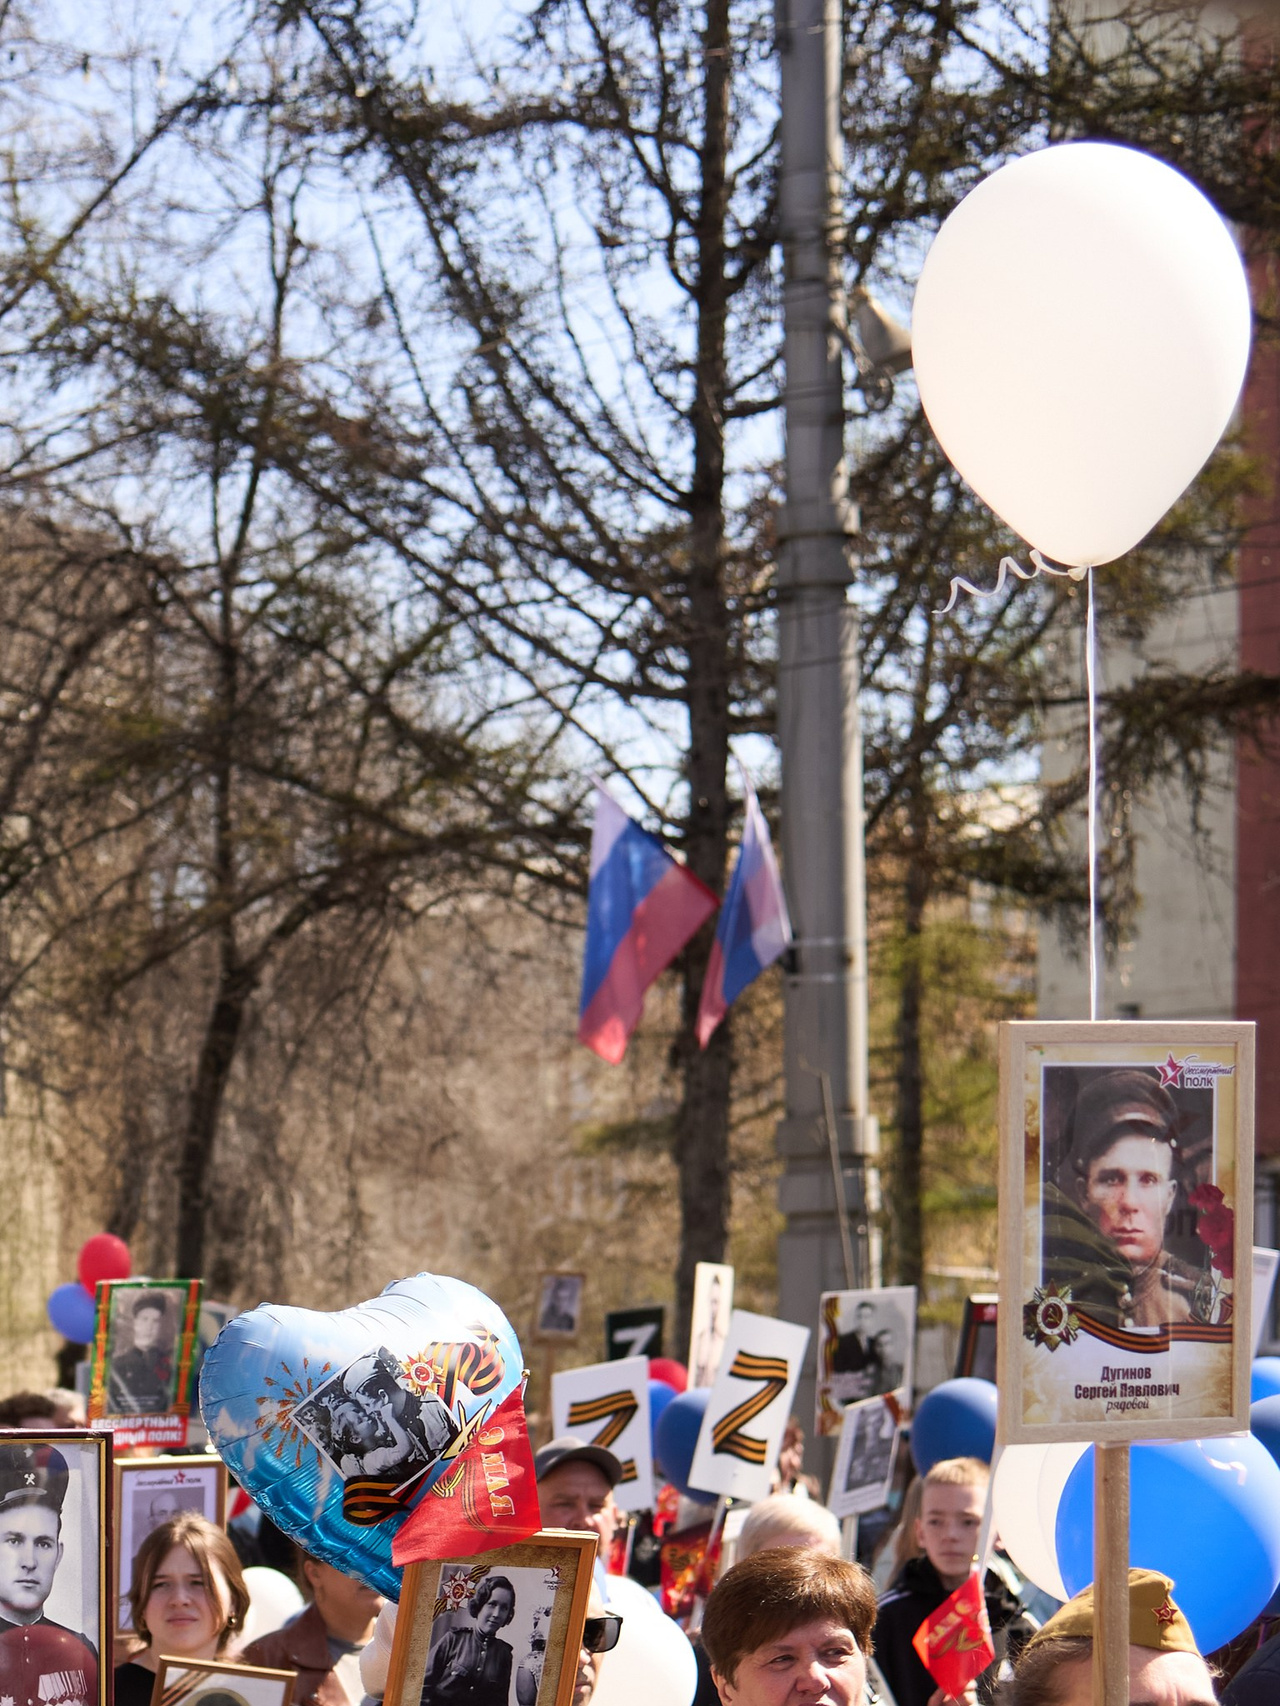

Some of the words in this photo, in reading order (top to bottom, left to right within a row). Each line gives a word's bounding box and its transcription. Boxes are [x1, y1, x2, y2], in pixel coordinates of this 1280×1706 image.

[1185, 1077, 1213, 1087] ПОЛК
[1101, 1366, 1152, 1383] Дугинов
[1075, 1383, 1117, 1400] Сергей
[1120, 1383, 1180, 1398] Павлович
[712, 1350, 787, 1465] Z
[1106, 1397, 1149, 1413] рядовой
